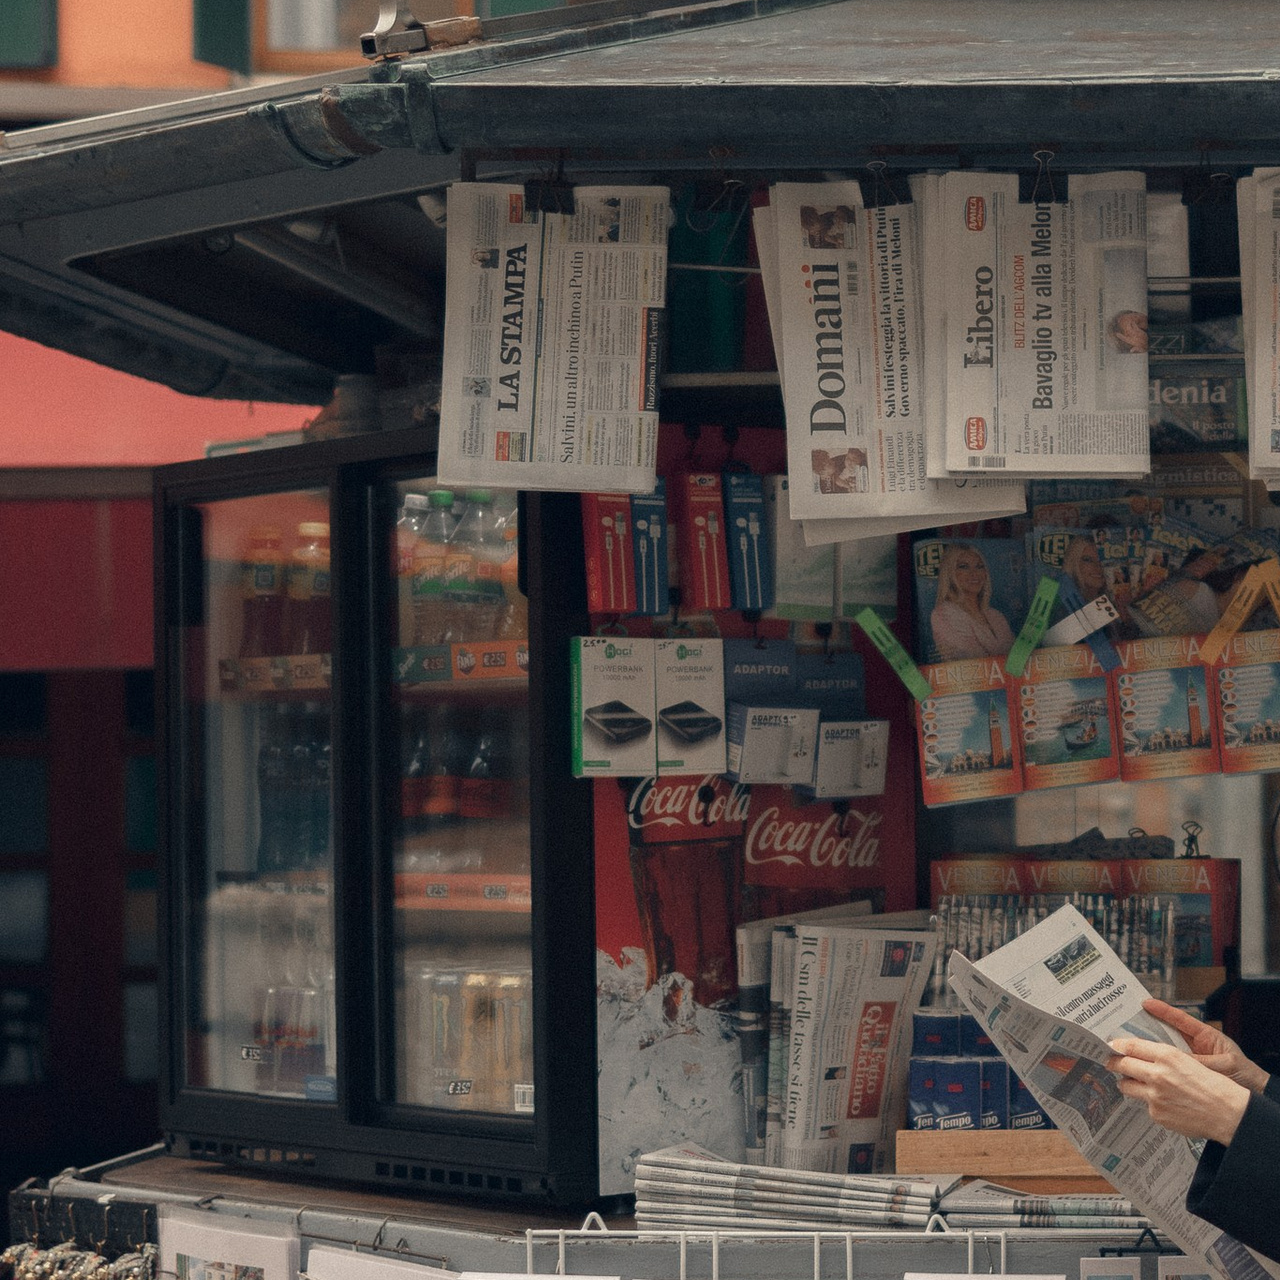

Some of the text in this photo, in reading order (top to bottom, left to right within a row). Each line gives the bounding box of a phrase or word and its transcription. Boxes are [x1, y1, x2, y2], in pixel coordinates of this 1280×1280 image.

[968, 197, 979, 229] AMICA
[568, 250, 584, 289] Putin
[888, 217, 911, 417] Governo spaccato, l'ira di Meloni
[963, 266, 995, 369] Libero
[1013, 254, 1026, 349] BLITZ DELL'AGCOM
[1030, 202, 1058, 410] Bavaglio tv alla Melon
[497, 242, 528, 412] LA STAMPA
[566, 300, 581, 353] inchino
[875, 241, 897, 418] Salvini festeggia la vittoria di
[646, 311, 659, 409] Razzismo, fuori Acerbi
[801, 261, 848, 436] Domani
[563, 355, 579, 390] altro
[1149, 377, 1228, 406] denia
[564, 390, 577, 409] un
[559, 411, 577, 464] Salvini,
[969, 418, 978, 450] AMICA
[593, 665, 644, 674] POWERBANK
[666, 665, 714, 674] POWERBANK
[733, 663, 790, 677] ADAPTOR
[1116, 636, 1201, 670] VENEZIA
[804, 679, 858, 691] ADAPTOR
[628, 774, 752, 830] Coca-Cola
[745, 806, 884, 868] Coca-Cola
[938, 865, 1021, 891] VENEZIA
[1030, 864, 1115, 890] VENEZIA
[1128, 864, 1212, 891] VENEZIA
[787, 936, 818, 1130] Il Csm delle tasse si tiene
[850, 1005, 883, 1116] Quotidiano
[865, 1022, 890, 1094] il Fatto
[937, 1112, 974, 1130] Tempo
[1010, 1111, 1044, 1130] Tempo
